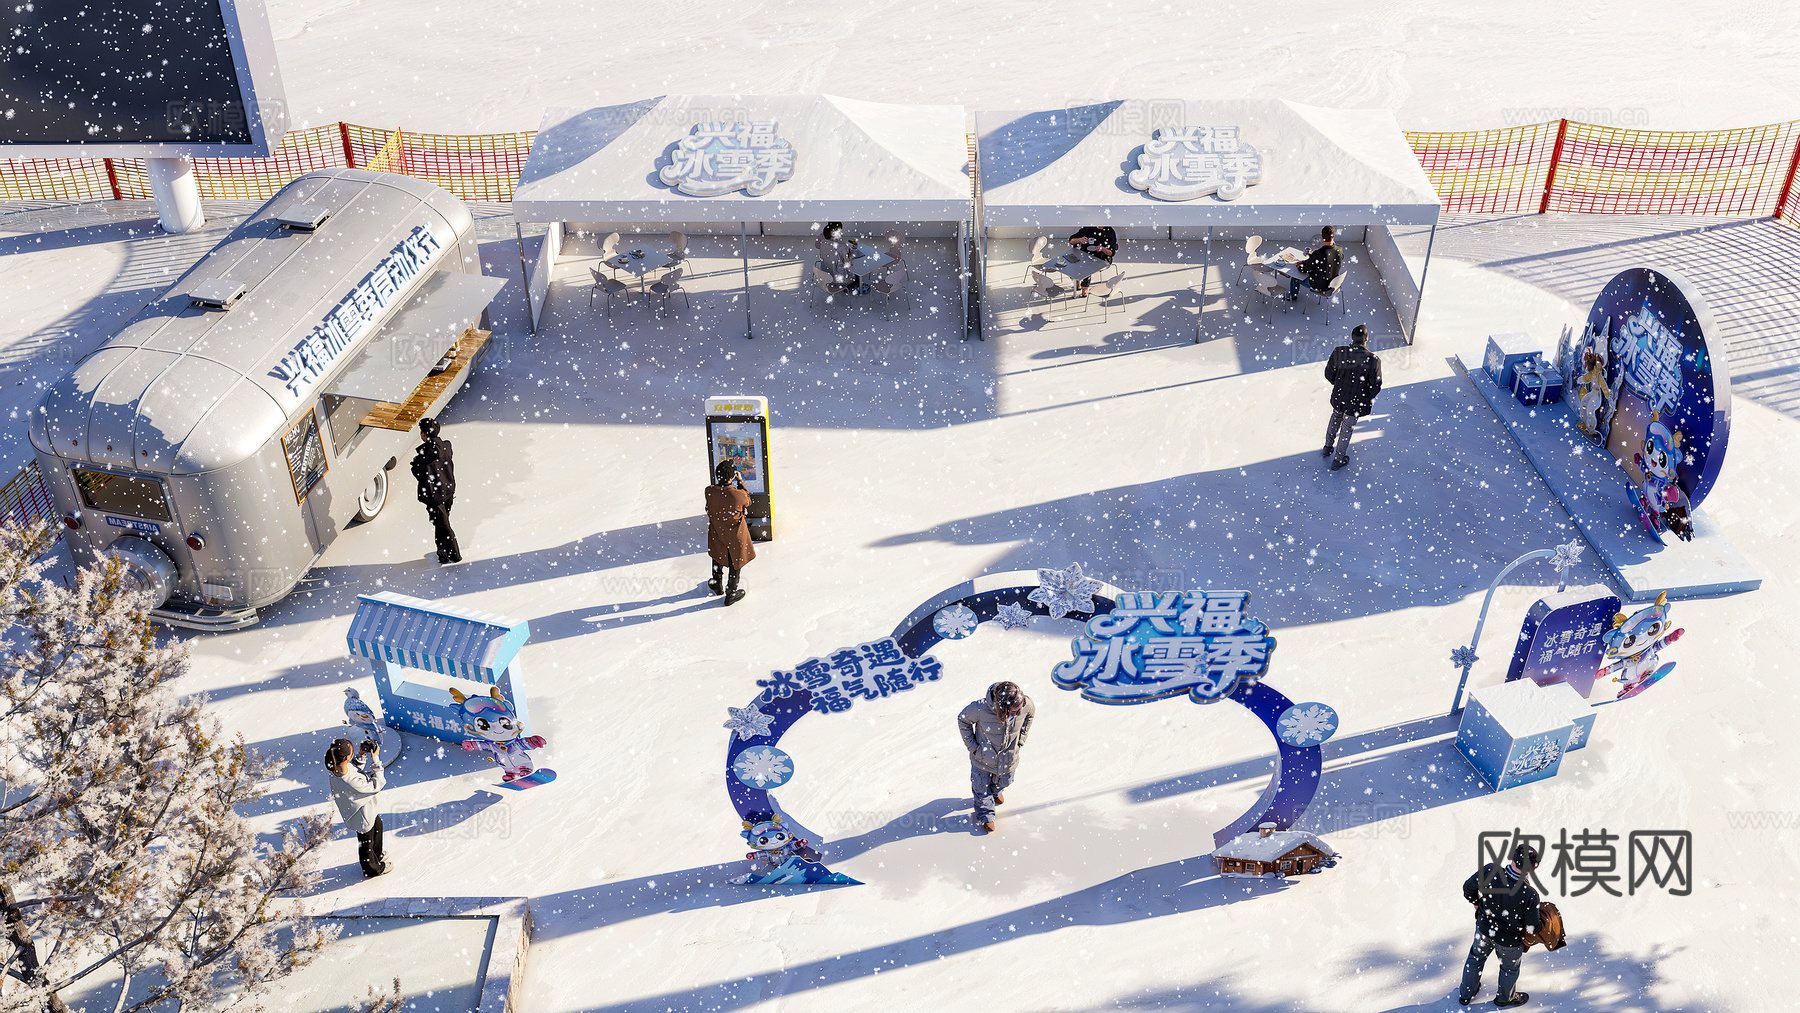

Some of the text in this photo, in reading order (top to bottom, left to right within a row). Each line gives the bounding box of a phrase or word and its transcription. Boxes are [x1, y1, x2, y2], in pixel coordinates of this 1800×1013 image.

[682, 122, 776, 150] 兴福
[1144, 126, 1239, 153] 兴福
[661, 148, 794, 184] 冰雪季
[1129, 152, 1260, 190] 冰雪季
[278, 220, 441, 397] 兴福冰雪季启动仪式
[1612, 327, 1682, 413] 冰雪季
[1088, 591, 1247, 636] 兴福
[1538, 640, 1597, 665] 福气随行
[1543, 623, 1603, 649] 冰雪奇遇
[756, 638, 907, 703] 冰雪奇遇
[1055, 634, 1269, 692] 冰雪季
[810, 656, 942, 714] 福气随行
[412, 711, 472, 737] 兴福冰
